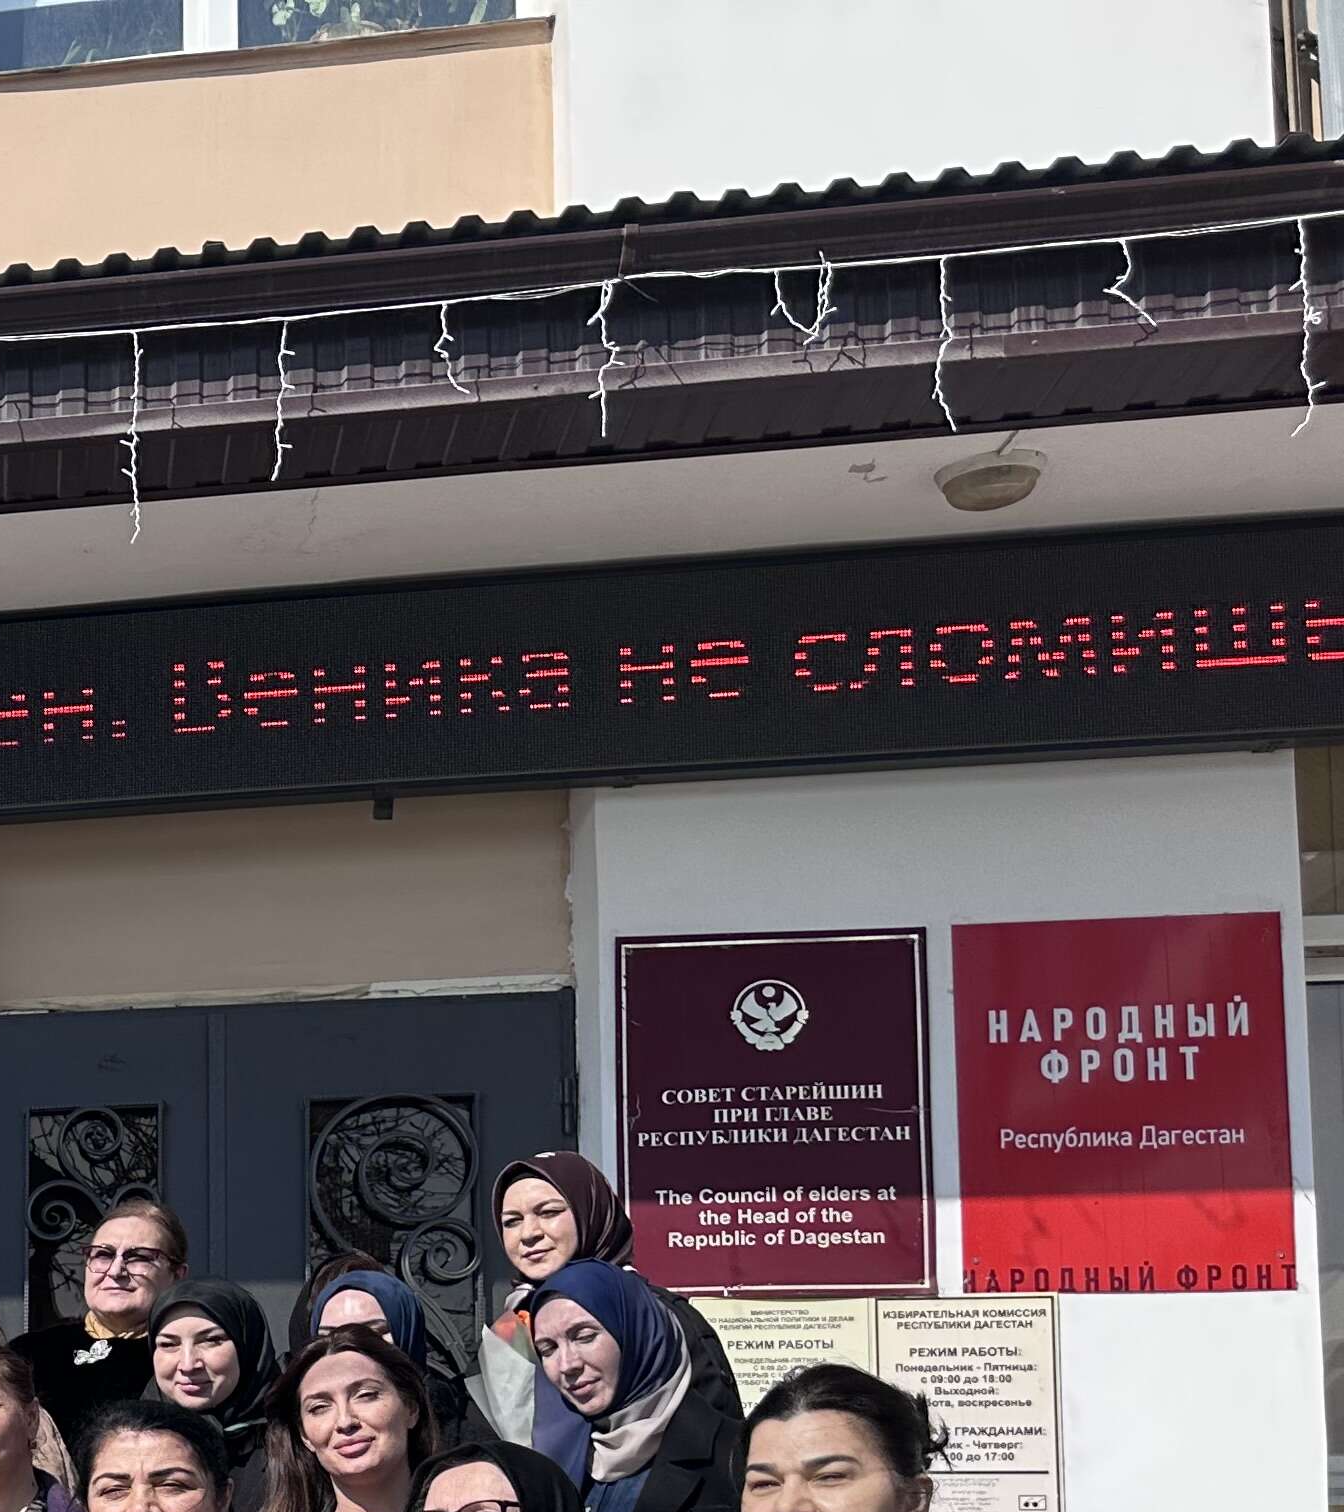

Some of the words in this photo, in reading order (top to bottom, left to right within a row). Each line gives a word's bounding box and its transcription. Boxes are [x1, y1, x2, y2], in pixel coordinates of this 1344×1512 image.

[172, 651, 570, 733] Веника
[619, 640, 750, 704] не
[988, 995, 1249, 1044] НАРОДНЫЙ
[1040, 1046, 1200, 1084] ФРОНТ
[661, 1088, 736, 1105] СОВЕТ
[740, 1081, 883, 1102] СТАРЕЙШИН
[714, 1108, 758, 1124] ПРИ
[765, 1106, 833, 1122] ГЛАВЕ
[637, 1128, 788, 1147] РЕСПУБЛИКИ
[793, 1125, 911, 1144] ДАГЕСТАН
[1000, 1126, 1133, 1154] Республика
[1139, 1125, 1245, 1150] Дагестан
[655, 1189, 693, 1206] The
[698, 1186, 777, 1205] Council
[783, 1186, 804, 1202] of
[809, 1185, 871, 1202] elders
[877, 1187, 897, 1201] at
[699, 1210, 731, 1225] the
[737, 1207, 790, 1224] Head
[795, 1207, 817, 1223] of
[820, 1207, 853, 1223] the
[668, 1230, 757, 1251] Republic
[763, 1229, 786, 1246] of
[790, 1228, 886, 1249] Dagestan
[963, 1261, 1155, 1292] НАРОДНЫЙ
[1176, 1263, 1296, 1290] ФРОНТ
[882, 1309, 979, 1320] ИЗБИРАТЕЛЬНАЯ
[982, 1308, 1047, 1318] КОМИССИЯ
[896, 1320, 971, 1330] РЕСПУБЛИКИ
[973, 1319, 1033, 1329] ДАГЕСТАН
[727, 1340, 774, 1350] РЕЖИМ
[778, 1339, 834, 1350] РАБОТЫ
[909, 1347, 958, 1357] РЕЖИМ
[961, 1346, 1022, 1357] РАБОТЫ:
[895, 1363, 974, 1373] Понедельник
[983, 1362, 1038, 1374] Пятница:
[930, 1374, 961, 1384] 09:00
[962, 1376, 979, 1384] до
[934, 1386, 999, 1396] Выходной:
[957, 1399, 1032, 1408] воскресенье
[972, 1440, 1024, 1451] Четверг:
[965, 1454, 982, 1463] до
[984, 1451, 1015, 1462] 17:00
